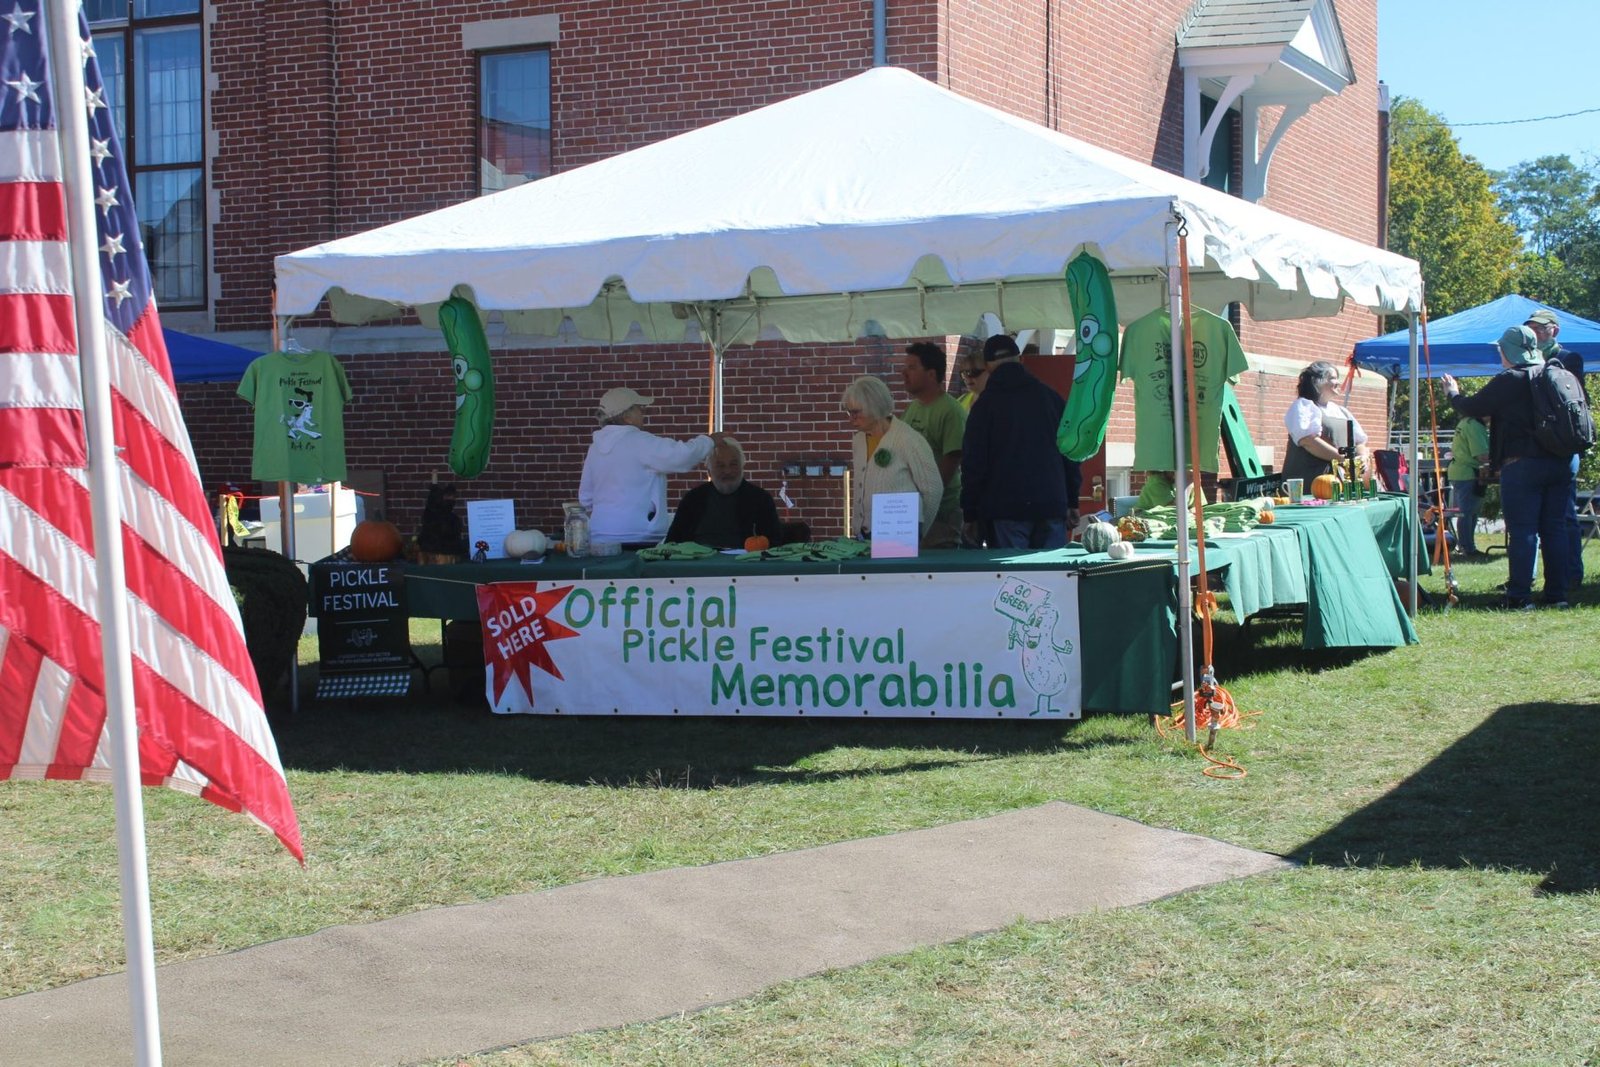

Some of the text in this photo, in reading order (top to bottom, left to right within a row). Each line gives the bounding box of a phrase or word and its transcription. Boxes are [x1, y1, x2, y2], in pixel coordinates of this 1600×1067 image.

[330, 568, 389, 587] PICKLE
[1014, 584, 1032, 598] GO
[323, 591, 399, 611] FESTIVAL
[487, 596, 537, 637] SOLD
[564, 585, 737, 629] Official
[1000, 591, 1033, 612] GREEN
[497, 618, 546, 660] HERE
[623, 626, 905, 665] Pickle Festival
[710, 661, 1016, 709] Memorabilia
